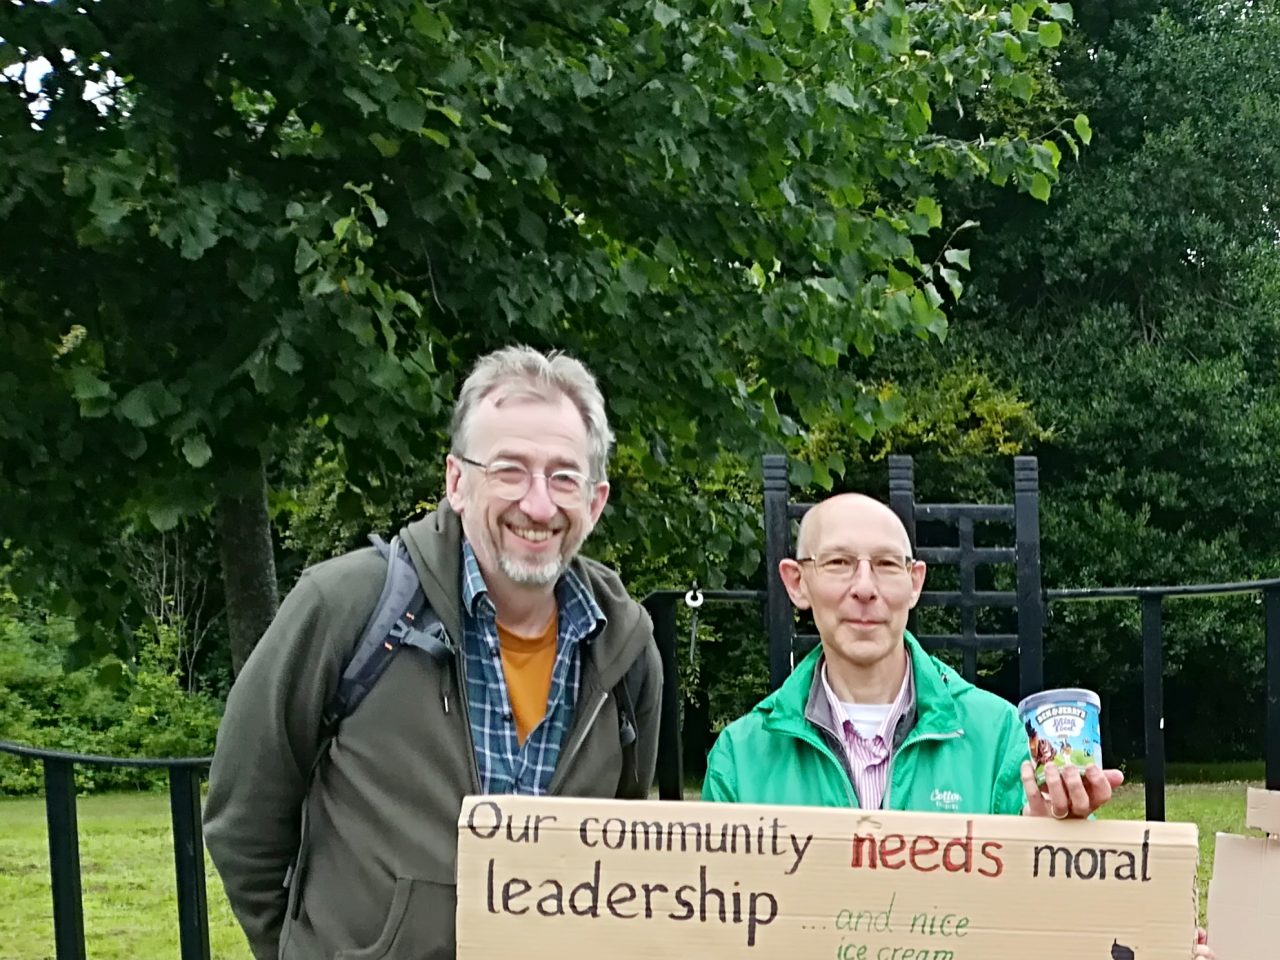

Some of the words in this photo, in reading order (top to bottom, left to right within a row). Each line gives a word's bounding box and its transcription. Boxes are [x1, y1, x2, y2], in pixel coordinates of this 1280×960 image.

[467, 801, 557, 843] Our
[579, 816, 814, 875] community
[851, 820, 1003, 877] needs
[1033, 829, 1152, 882] moral
[486, 859, 779, 947] leadership
[909, 905, 970, 938] nice
